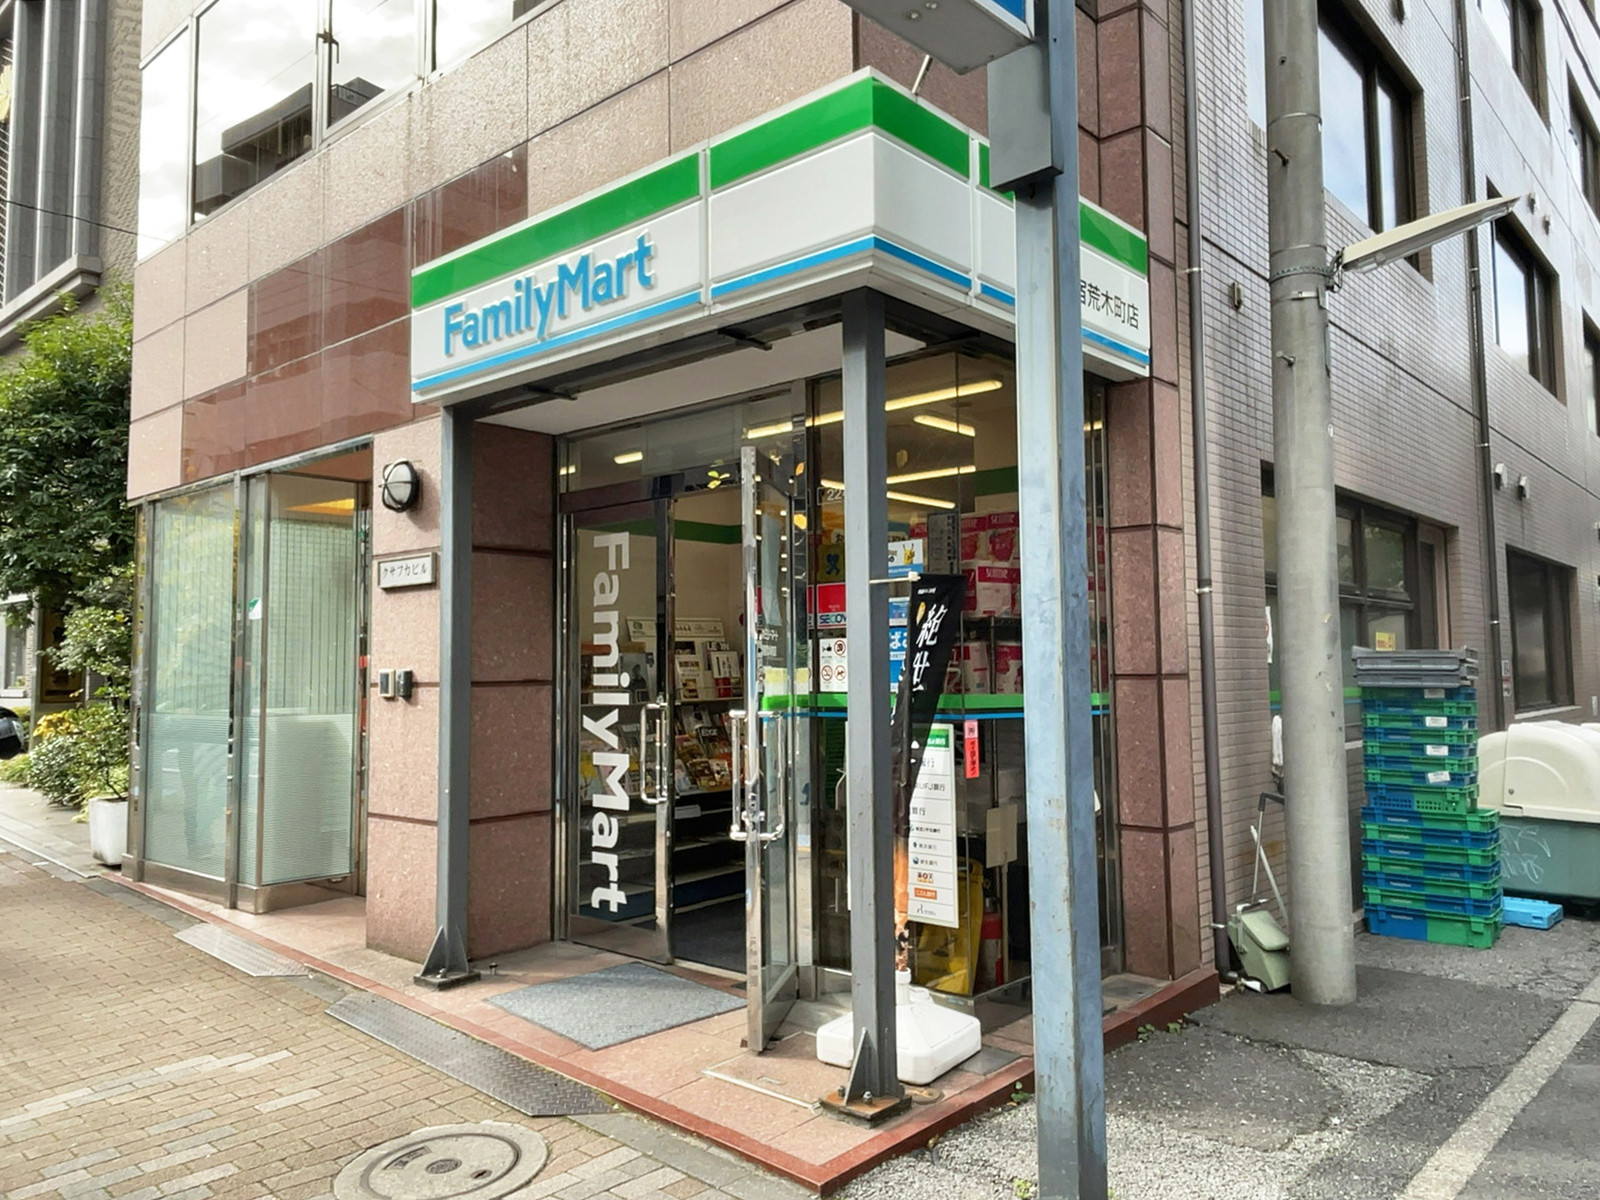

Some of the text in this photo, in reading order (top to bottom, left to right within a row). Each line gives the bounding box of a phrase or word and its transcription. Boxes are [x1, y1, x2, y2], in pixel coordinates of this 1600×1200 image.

[444, 236, 654, 357] FamilyMart
[826, 488, 845, 501] 22
[582, 531, 629, 912] FamilyMart
